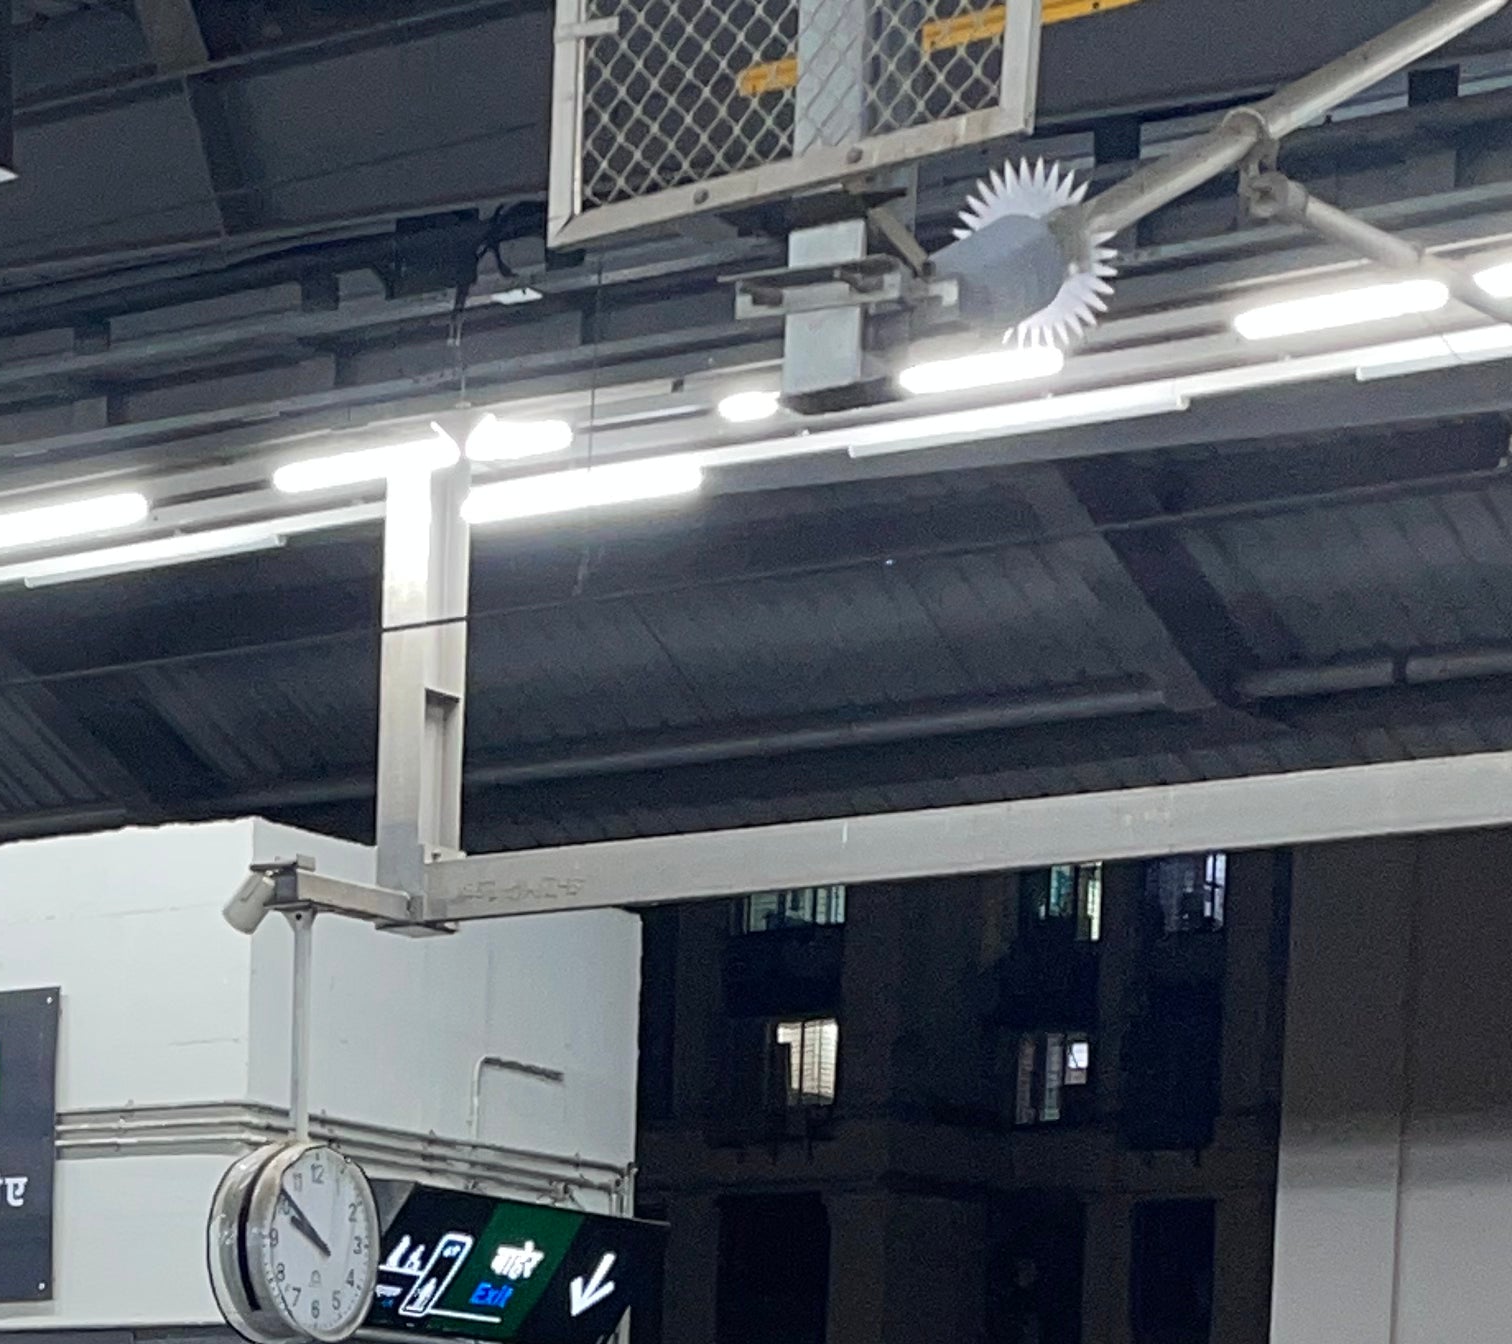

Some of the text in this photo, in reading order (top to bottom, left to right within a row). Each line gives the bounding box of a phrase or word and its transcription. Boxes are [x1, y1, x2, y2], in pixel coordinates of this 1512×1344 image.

[310, 1163, 324, 1184] 12
[353, 1236, 362, 1254] 3
[276, 1263, 285, 1282] 8
[346, 1269, 355, 1287] 4
[292, 1286, 302, 1307] 7
[469, 1282, 514, 1308] Exit
[310, 1300, 320, 1318] 6
